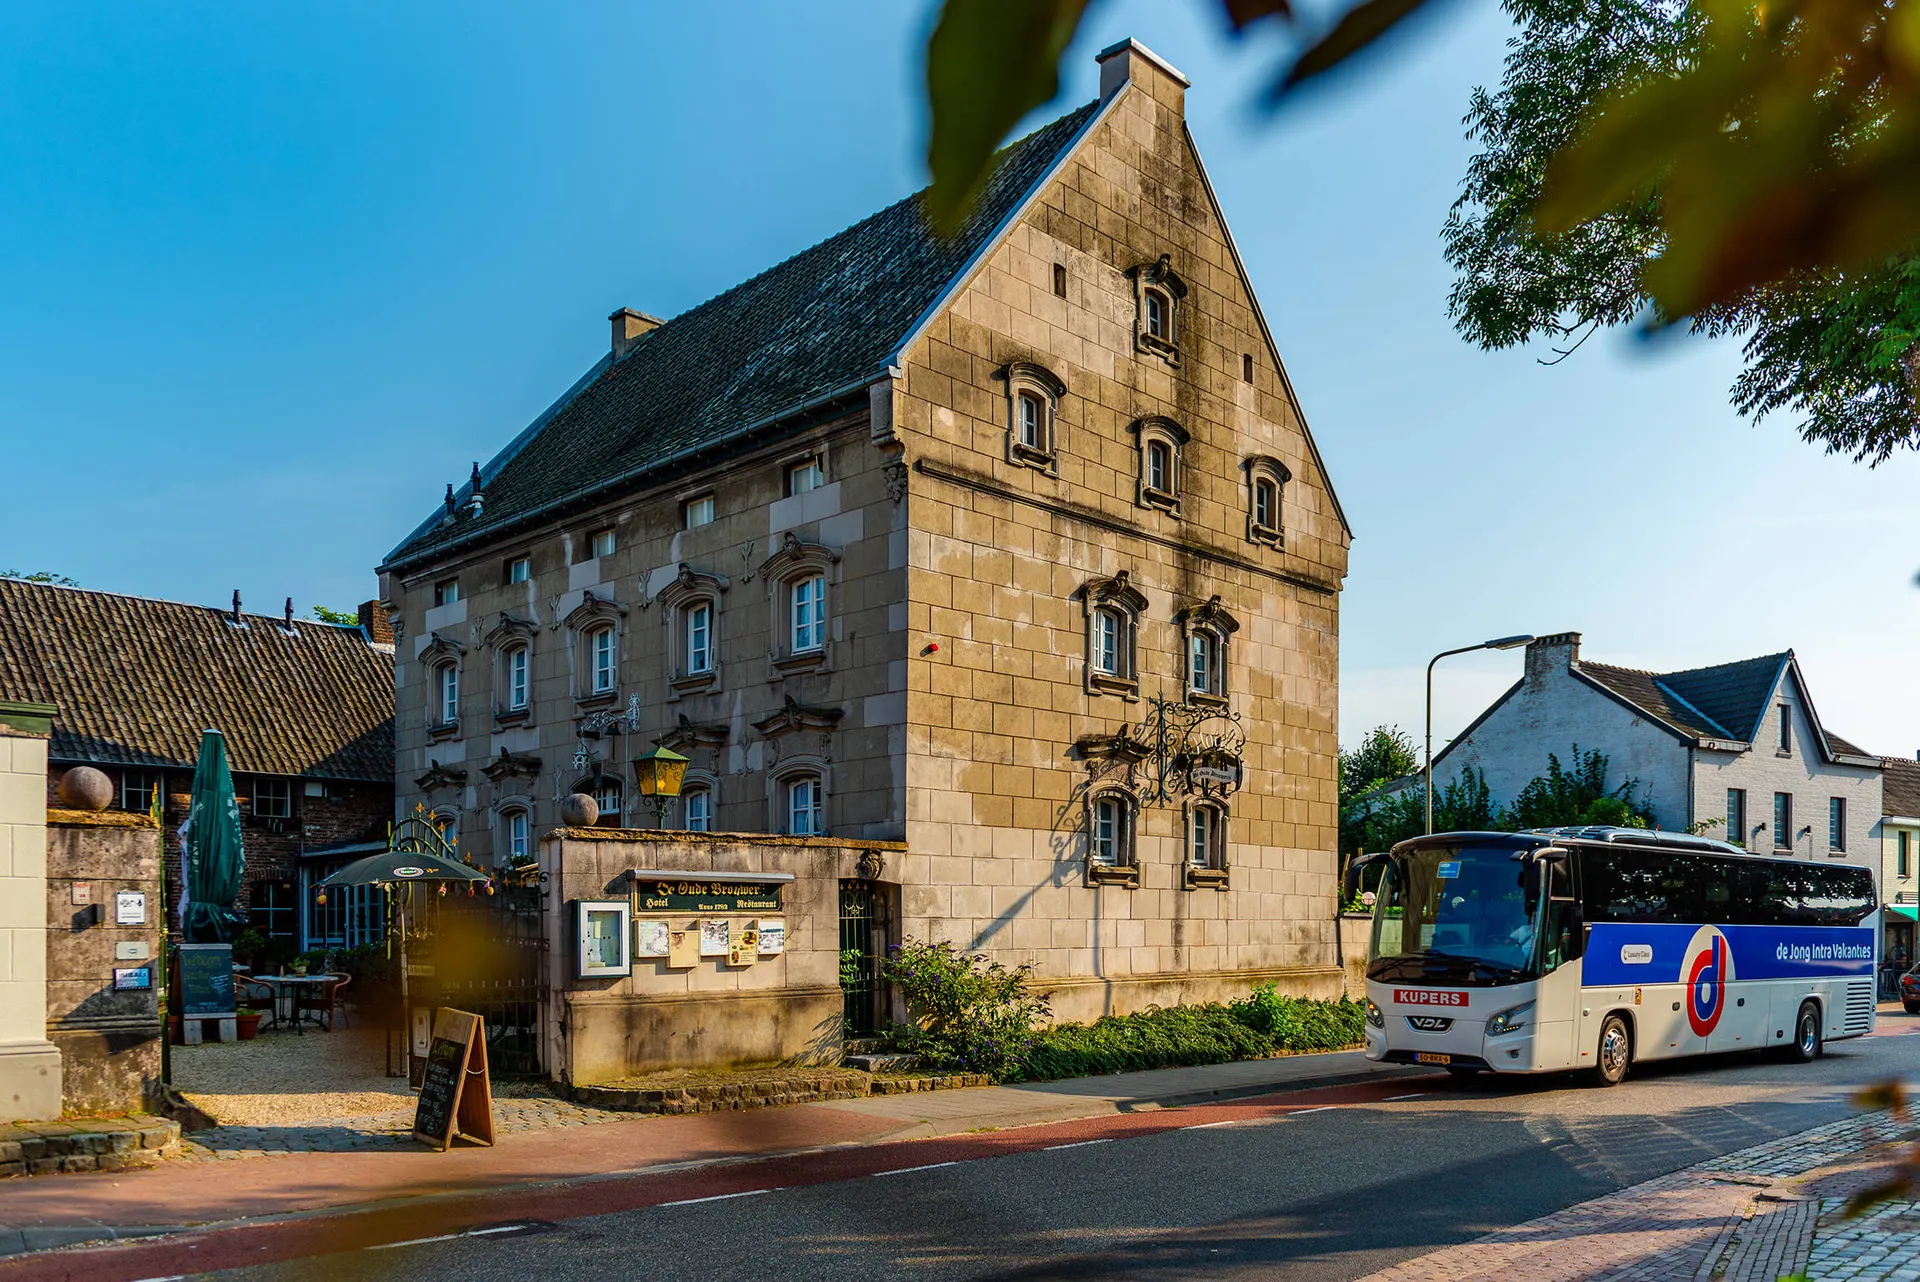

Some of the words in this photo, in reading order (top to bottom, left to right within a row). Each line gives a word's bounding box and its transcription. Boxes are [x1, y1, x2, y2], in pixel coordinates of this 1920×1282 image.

[657, 882, 675, 896] De
[678, 881, 708, 896] Oude
[646, 897, 669, 909] Hotel
[736, 899, 777, 909] Restaurant
[1628, 951, 1641, 959] Luxury
[1776, 942, 1788, 960] de
[1789, 943, 1811, 963] Jong
[1812, 943, 1832, 959] Intra
[1832, 942, 1871, 959] Vakanties
[1400, 991, 1460, 1005] KUPERS
[1412, 1018, 1446, 1028] VDL
